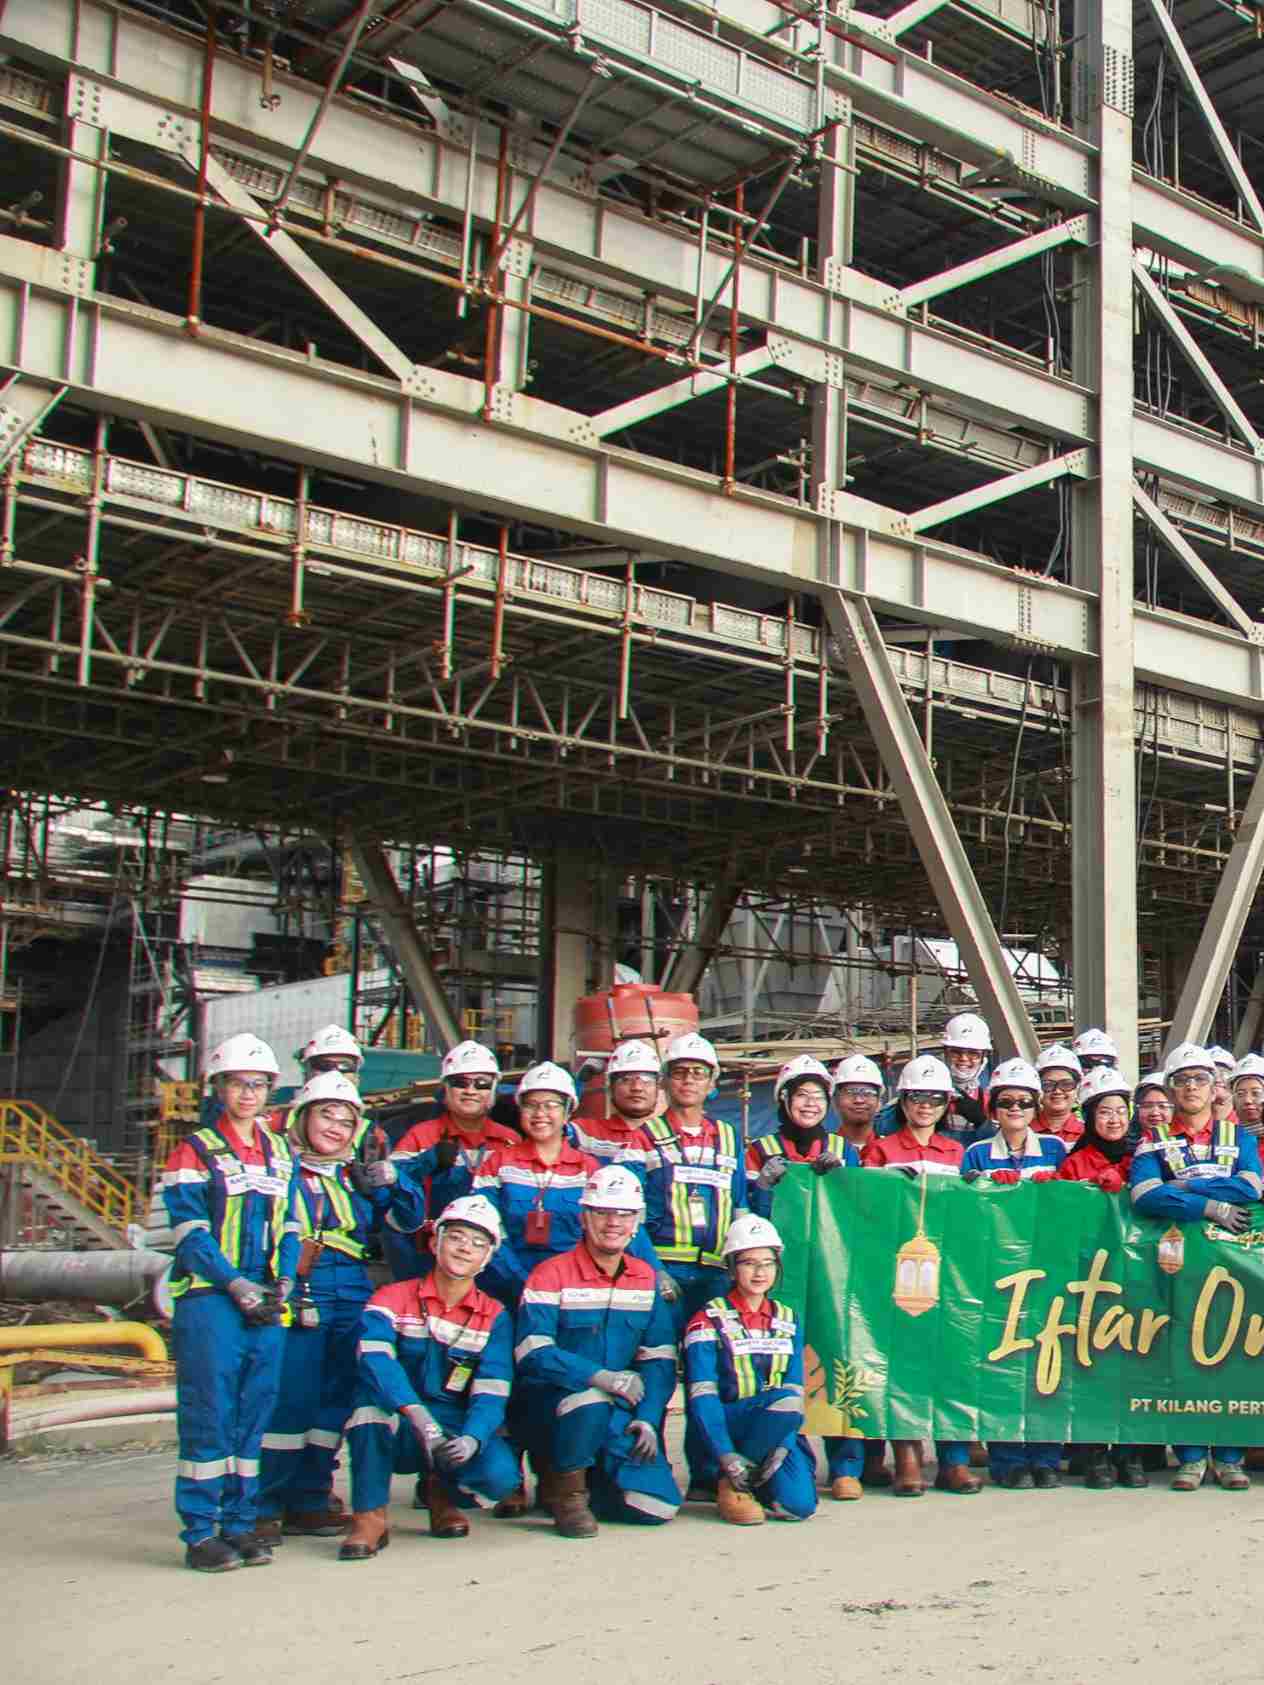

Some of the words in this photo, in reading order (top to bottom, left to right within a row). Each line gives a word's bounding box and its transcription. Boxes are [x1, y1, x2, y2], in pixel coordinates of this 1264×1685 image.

[988, 1248, 1170, 1394] Iftar
[1130, 1398, 1152, 1412] PT
[1156, 1398, 1222, 1413] KILANG
